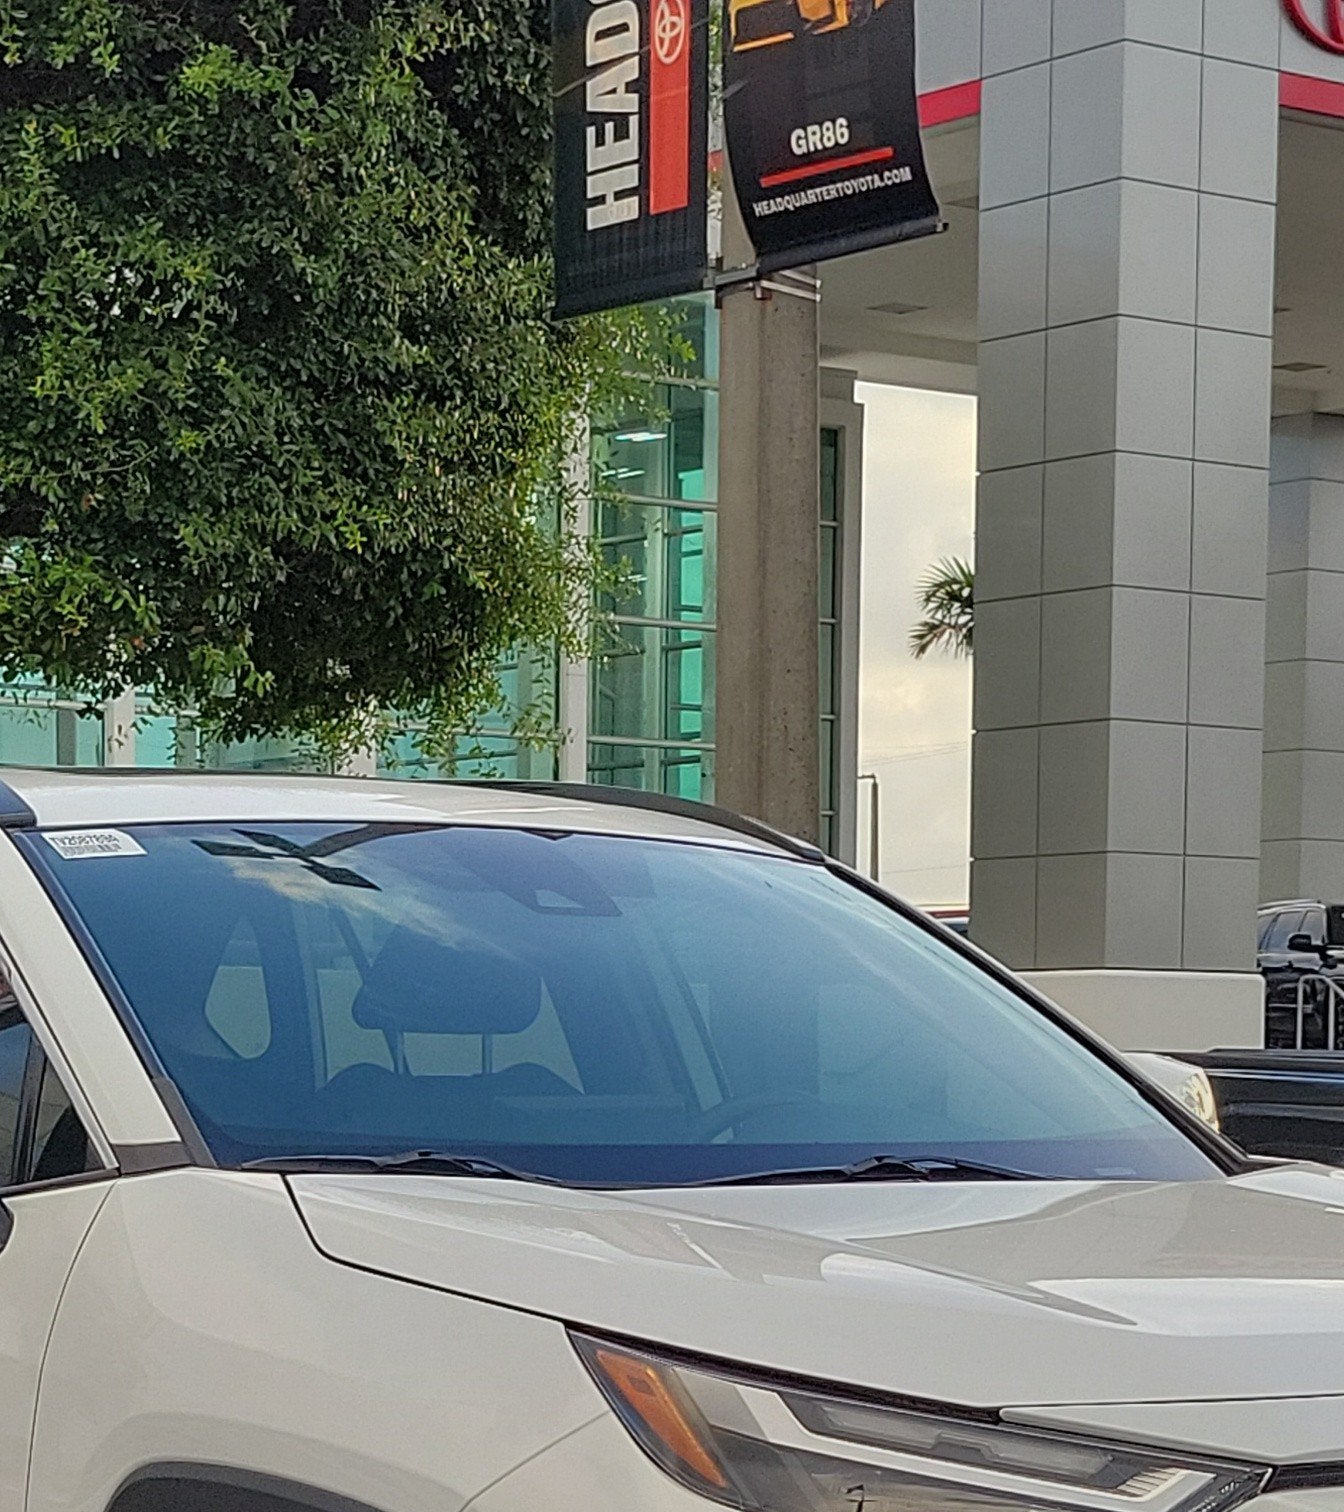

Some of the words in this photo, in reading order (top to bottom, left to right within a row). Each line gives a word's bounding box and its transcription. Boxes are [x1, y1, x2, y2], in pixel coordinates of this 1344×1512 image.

[586, 0, 640, 231] HEAD
[790, 117, 849, 155] GR86
[752, 166, 913, 217] HEADQUARTERTOYOTA.COM
